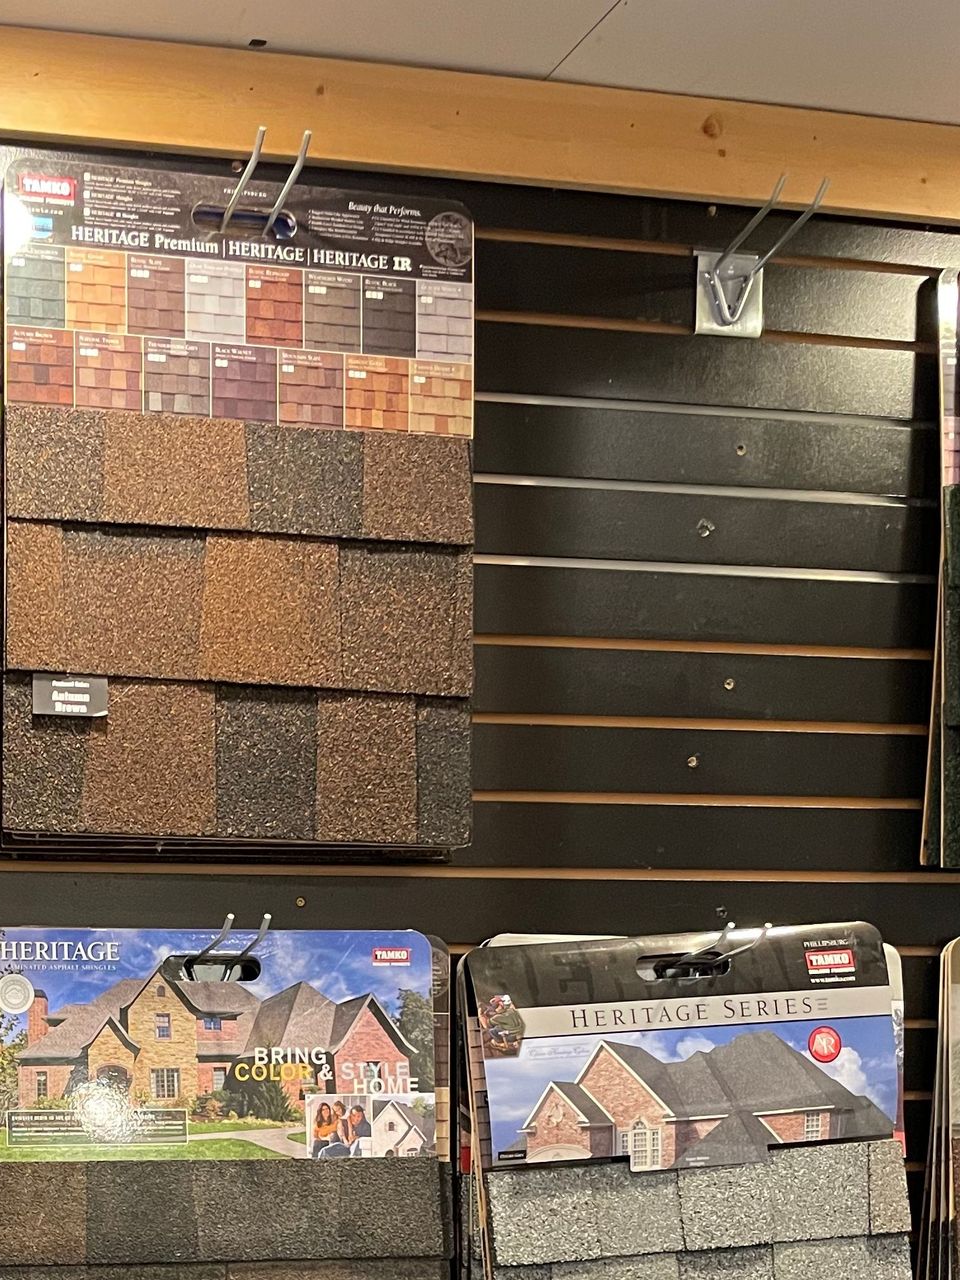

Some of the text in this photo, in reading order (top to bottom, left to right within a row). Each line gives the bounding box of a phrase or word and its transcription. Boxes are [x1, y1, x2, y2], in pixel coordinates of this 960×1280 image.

[22, 176, 71, 196] TAMKO
[348, 201, 373, 214] Beauty
[373, 204, 388, 213] that
[71, 225, 150, 248] HERITAGE
[154, 234, 219, 254] Premium
[228, 240, 305, 262] HERITAGE
[313, 248, 388, 270] HERITAGE
[392, 256, 412, 271] IR
[51, 690, 90, 702] Autumn
[55, 701, 88, 713] Brown
[0, 941, 120, 961] HERITAGE
[375, 950, 408, 960] TAMKO
[808, 953, 850, 966] TAMKO
[570, 997, 814, 1028] HERITAGE SERIES
[253, 1047, 327, 1065] BRING
[234, 1060, 410, 1081] COLOR & STYLE
[353, 1077, 419, 1094] HOME
